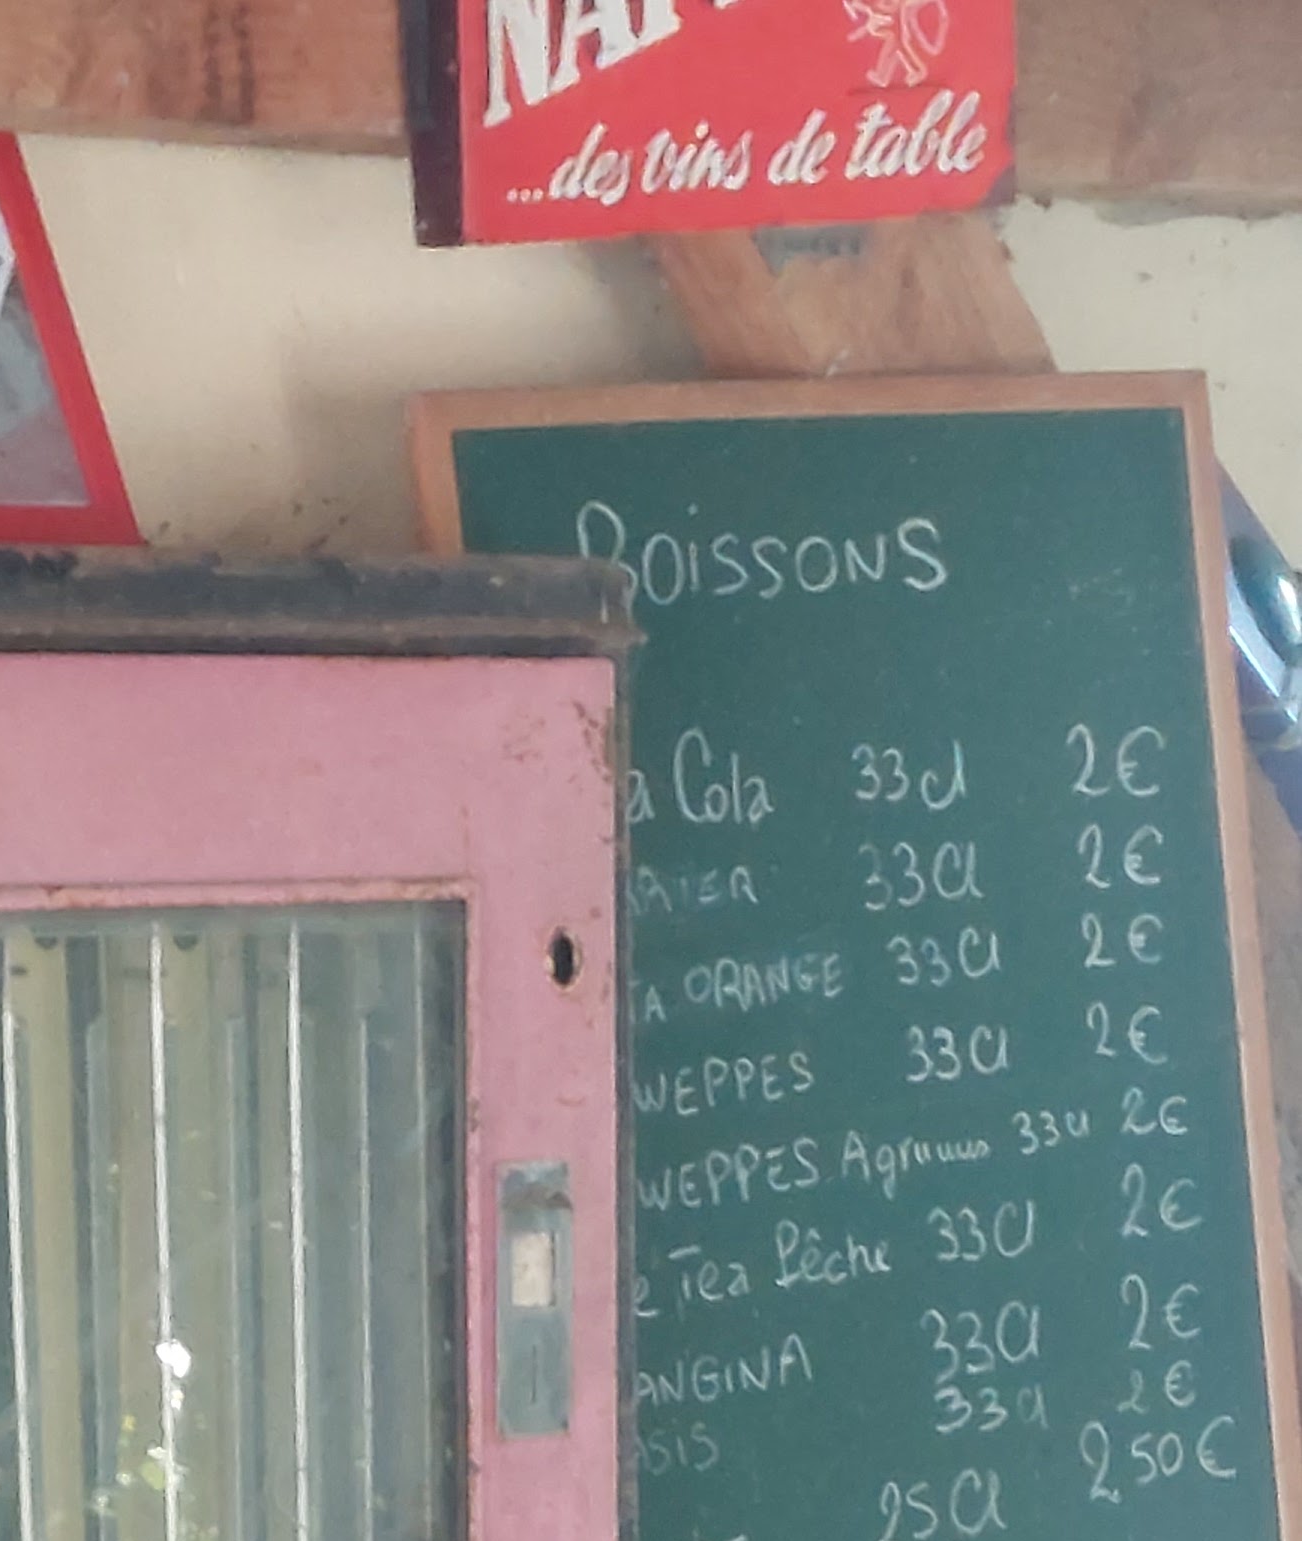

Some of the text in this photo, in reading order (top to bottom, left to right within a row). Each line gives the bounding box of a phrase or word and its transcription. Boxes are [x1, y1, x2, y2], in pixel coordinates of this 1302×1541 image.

[641, 118, 752, 194] vins
[767, 107, 837, 186] de
[845, 88, 988, 181] table
[672, 727, 775, 828] Cola
[1066, 723, 1165, 796] 2€
[1078, 824, 1164, 889] 2€
[683, 953, 844, 1012] ORANGE
[1082, 913, 1164, 968] 2€
[1086, 1002, 1168, 1064] 2€
[1121, 1086, 1189, 1136] 2€
[668, 1245, 750, 1301] Tea
[1121, 1163, 1202, 1238] 2€
[1120, 1274, 1200, 1350] 2€
[1117, 1360, 1196, 1414] 2€
